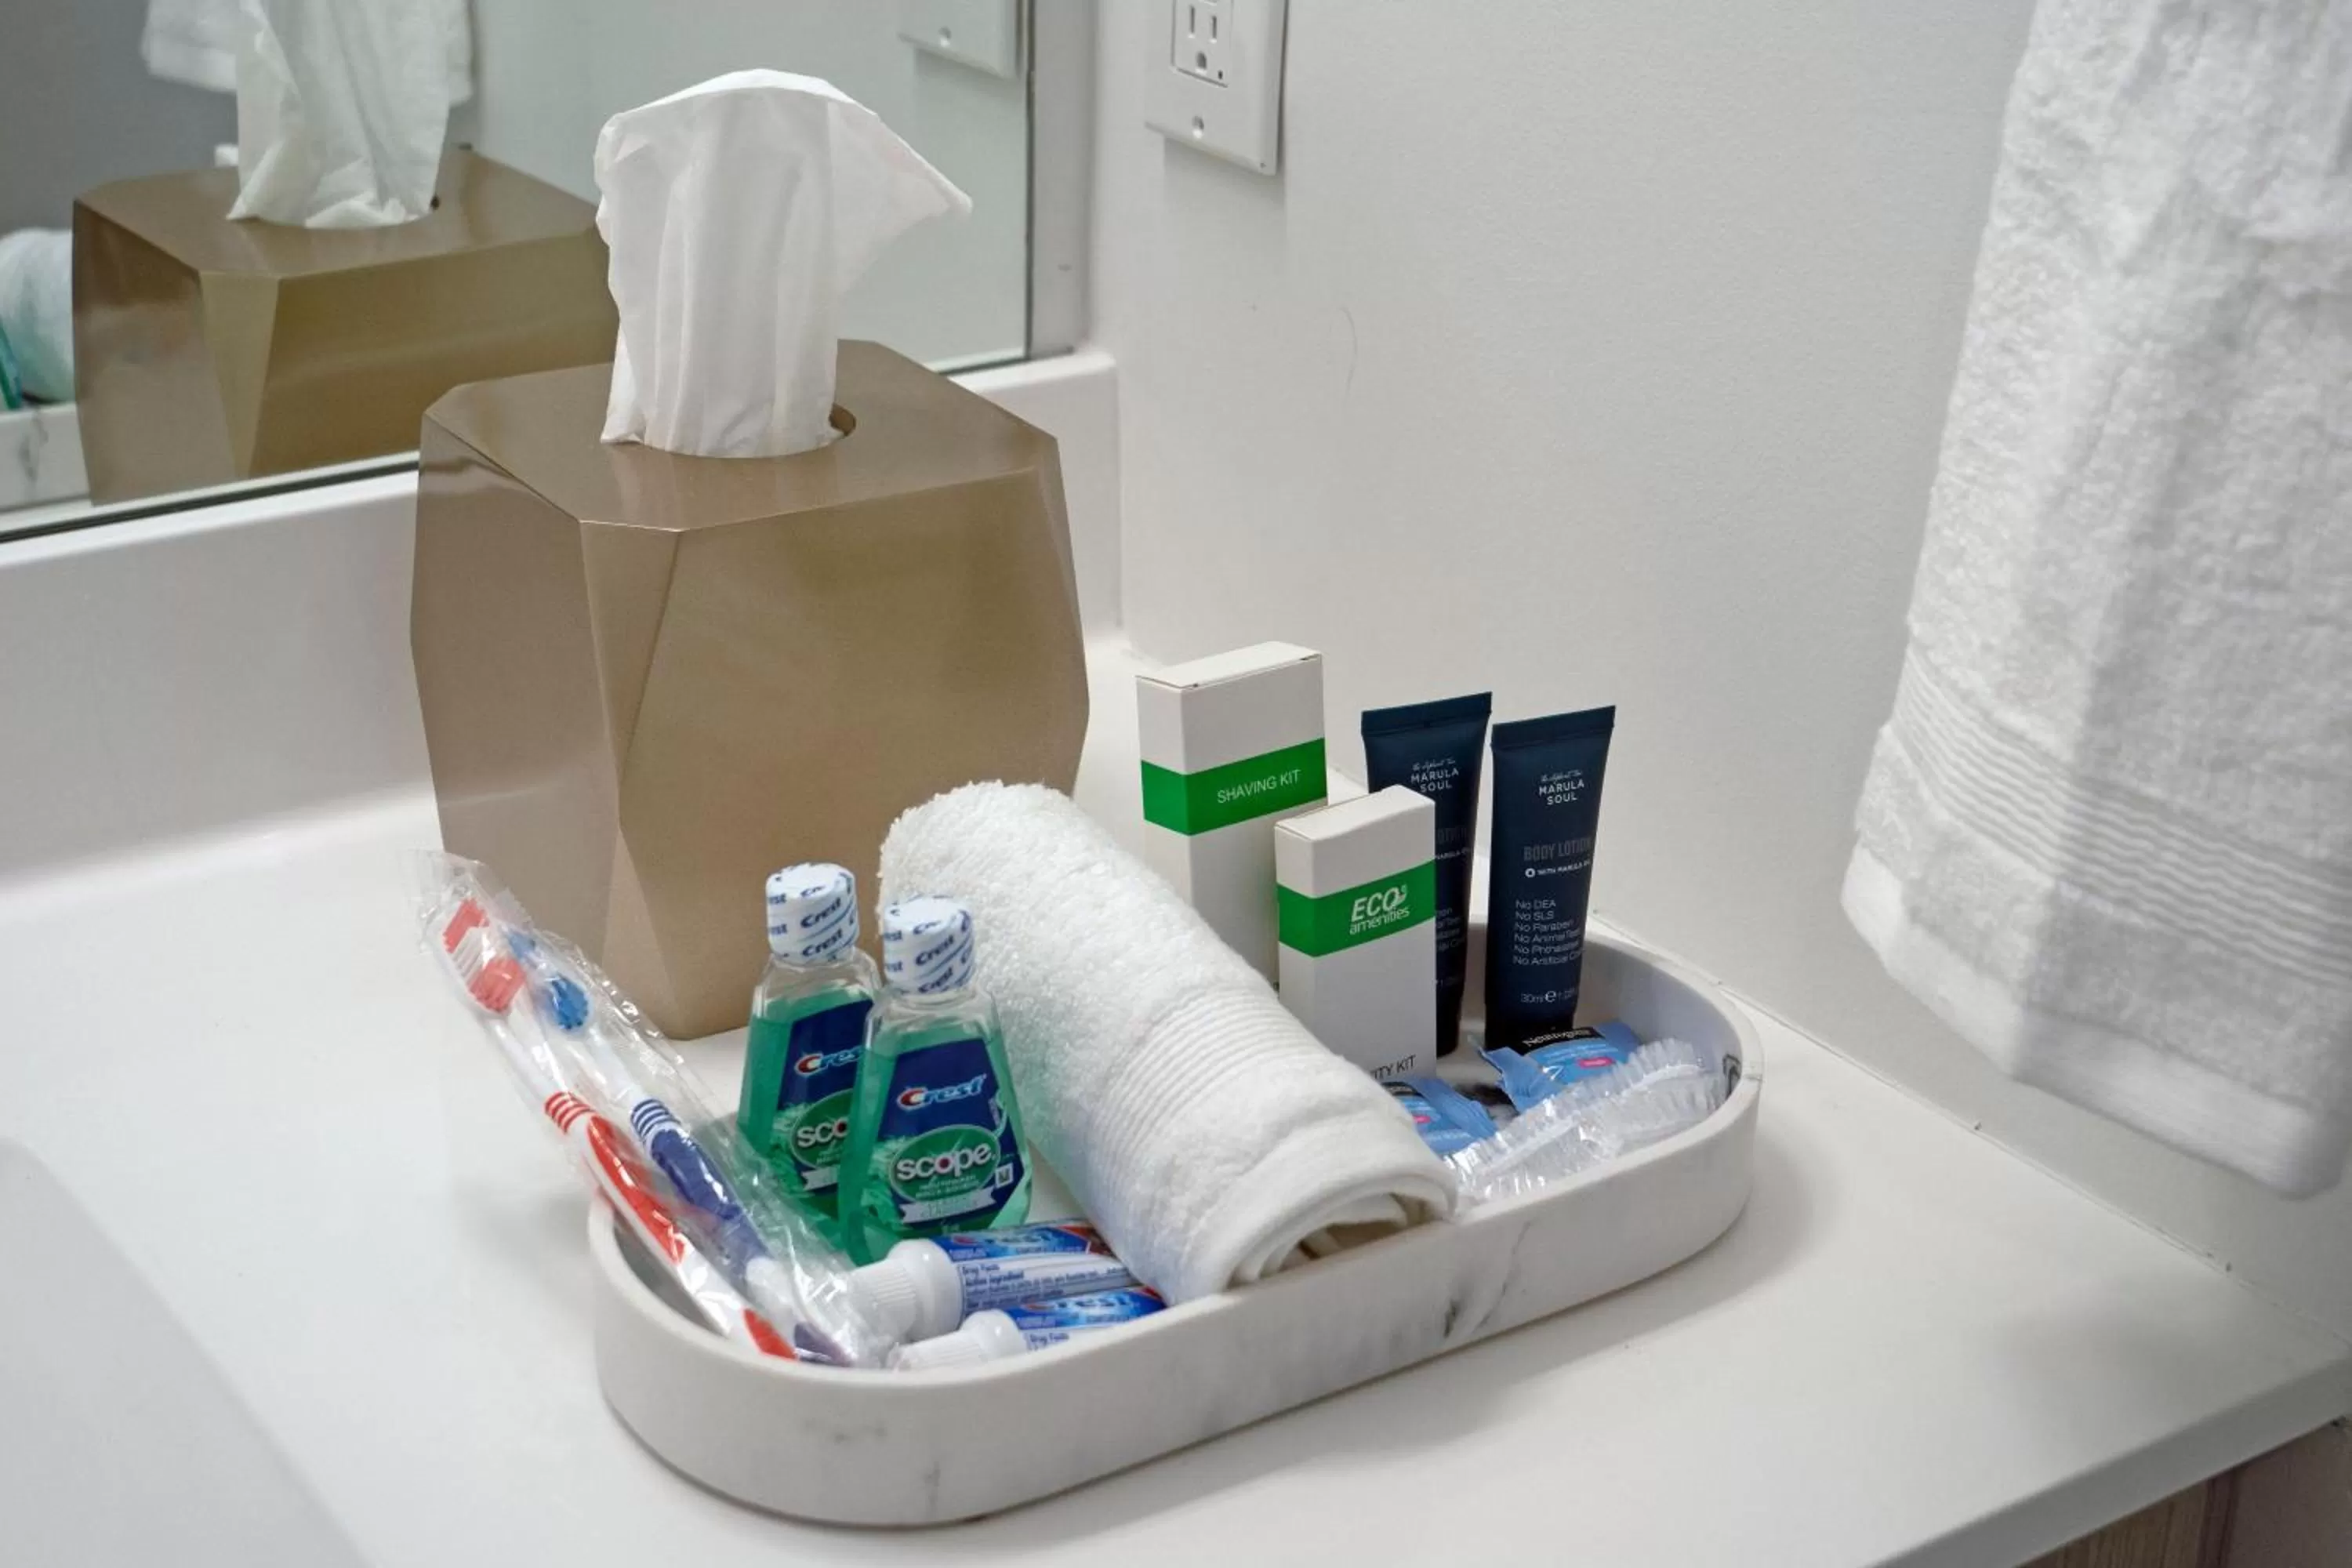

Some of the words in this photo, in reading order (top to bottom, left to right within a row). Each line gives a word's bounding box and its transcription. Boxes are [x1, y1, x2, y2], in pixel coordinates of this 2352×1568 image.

[1217, 776, 1277, 804] SHAVING
[1279, 768, 1301, 789] KIT
[1410, 768, 1460, 785] MARULA
[1420, 779, 1453, 793] SOUL
[1538, 779, 1584, 797] MARULA
[1546, 791, 1577, 806] SOUL
[1523, 843, 1556, 862] BODY
[800, 898, 841, 928] Crest
[1350, 885, 1403, 923] ECO
[1515, 899, 1531, 909] No
[1533, 898, 1556, 909] DEA
[1348, 906, 1411, 935] amenities
[1515, 910, 1531, 921] No
[1533, 909, 1555, 921] SLS
[1514, 921, 1531, 932] No
[801, 929, 843, 957] Crest
[1514, 932, 1530, 944] No
[914, 935, 955, 966] Crest
[1513, 943, 1530, 954] No
[1512, 954, 1530, 965] No
[917, 967, 953, 994] Crest
[793, 1044, 866, 1078] Cres
[1396, 1054, 1416, 1073] KIT
[897, 1073, 985, 1111] Crest
[796, 1116, 850, 1149] sco
[896, 1142, 993, 1181] scope
